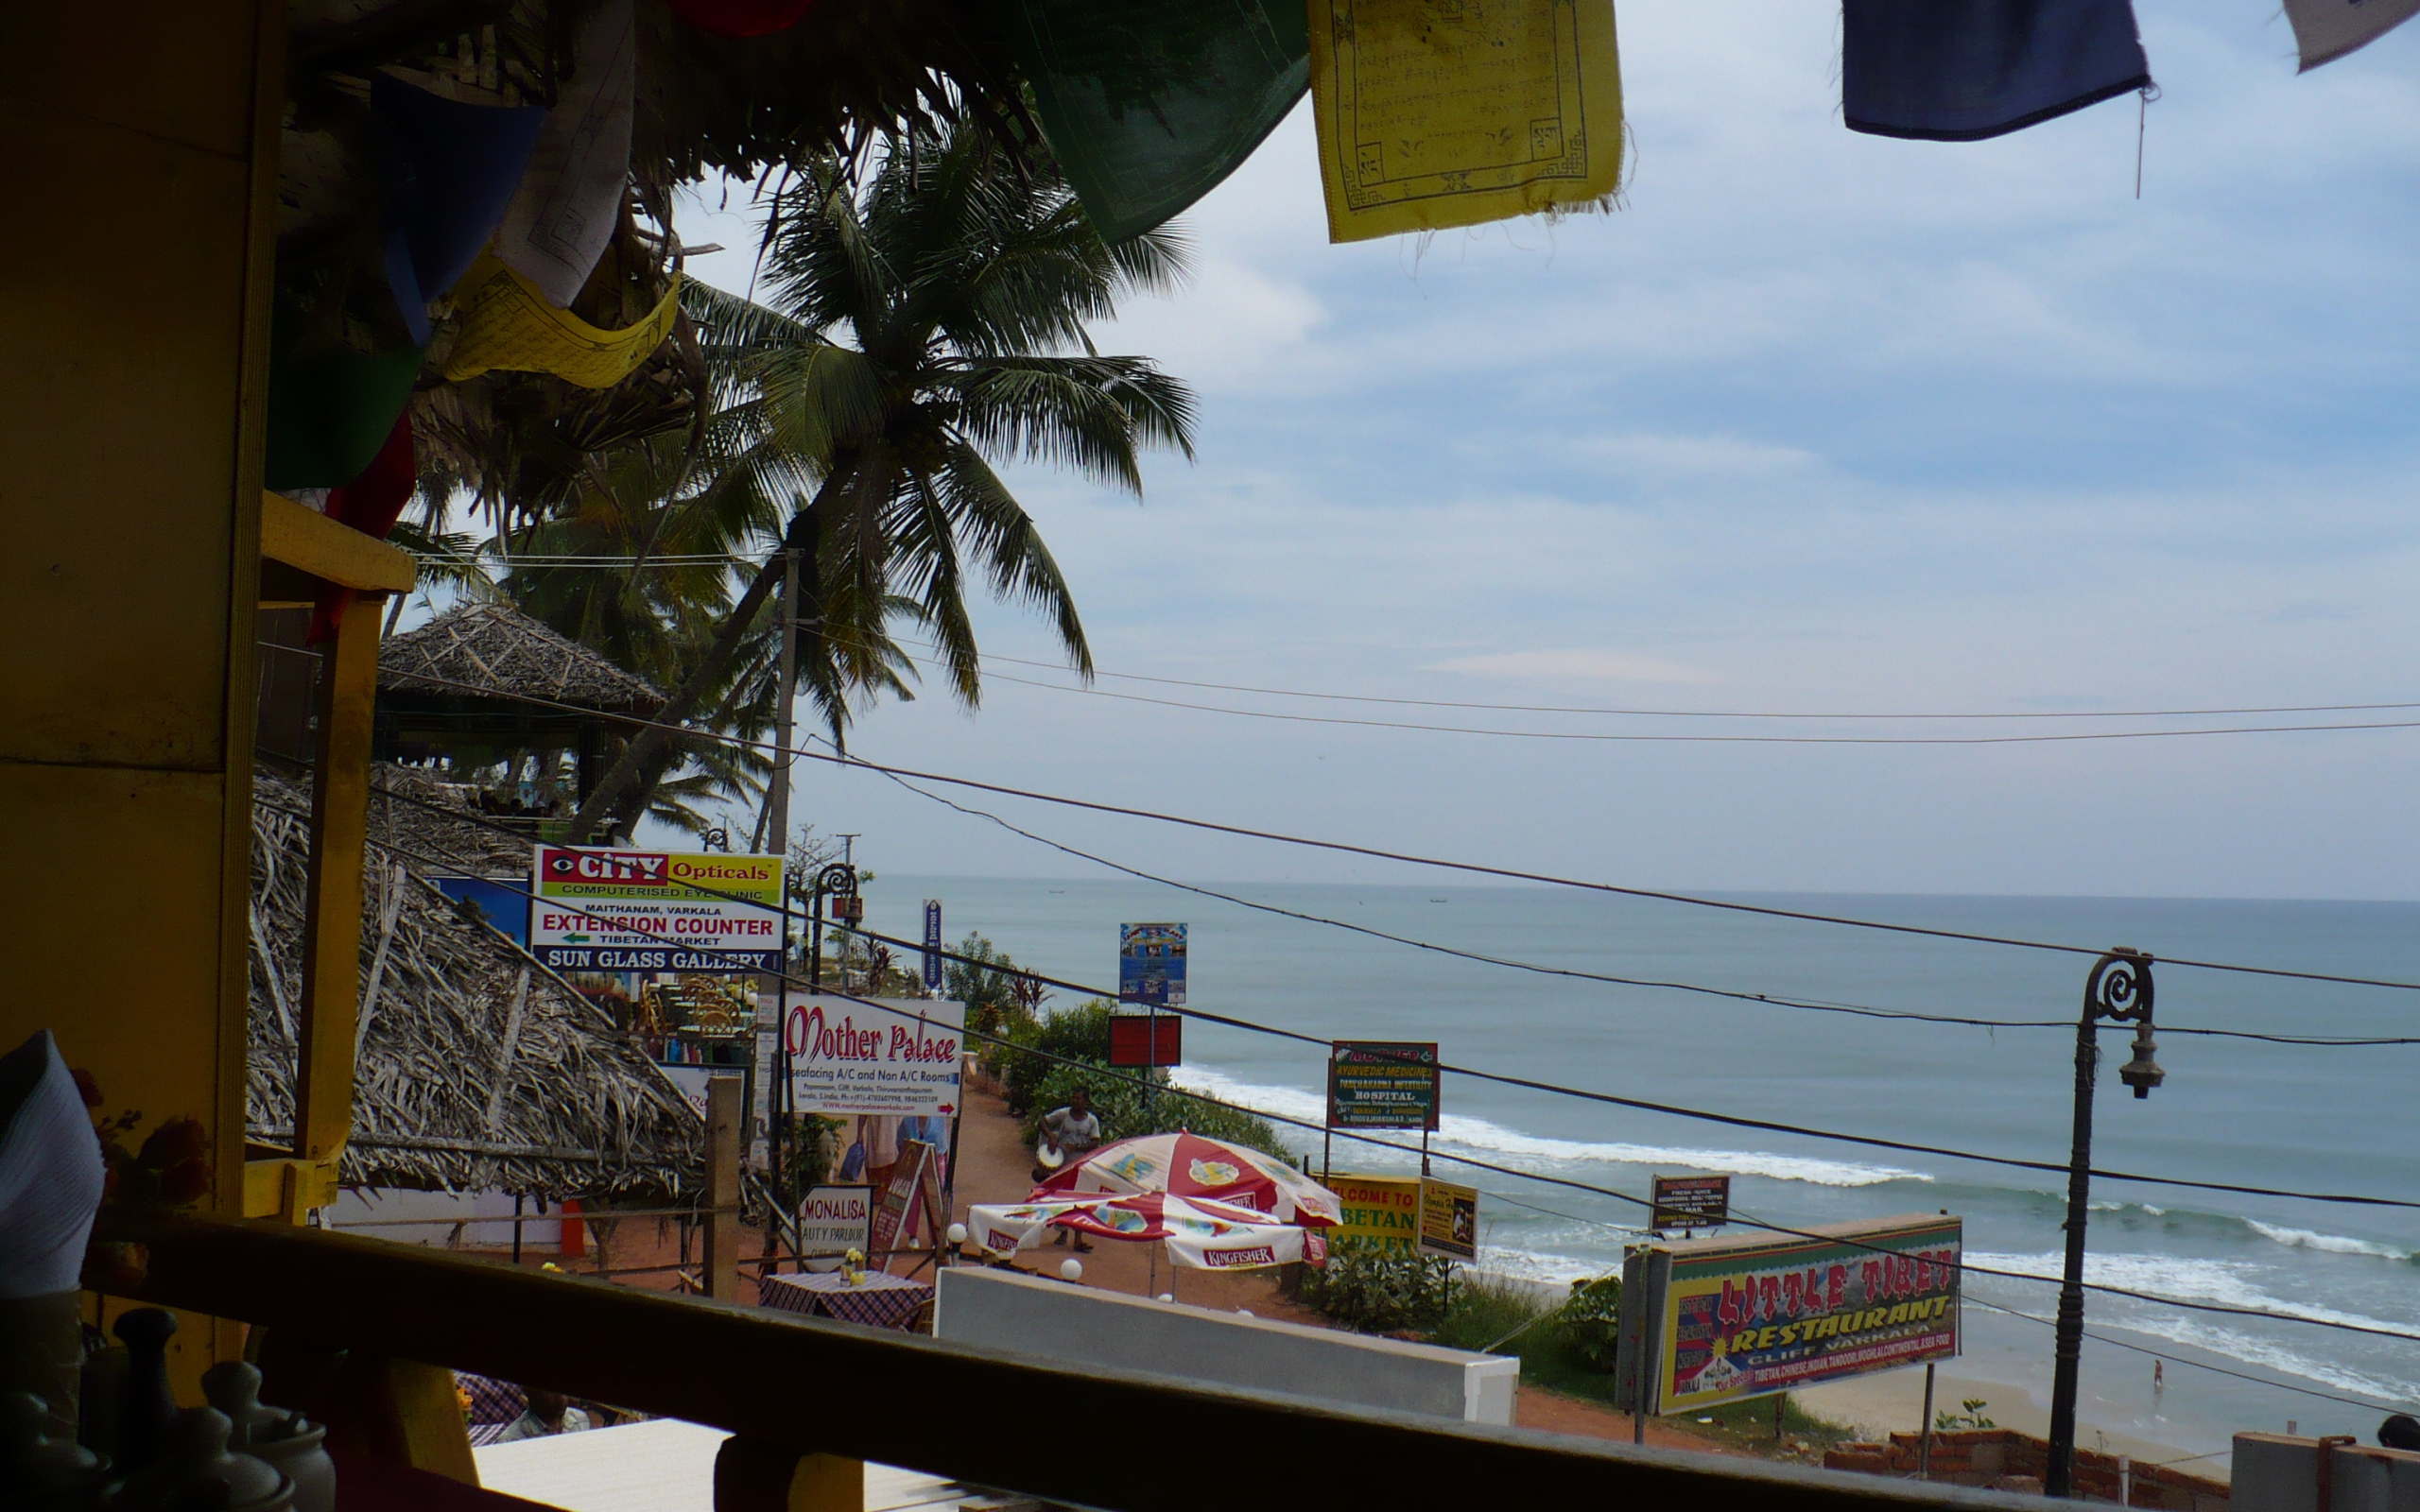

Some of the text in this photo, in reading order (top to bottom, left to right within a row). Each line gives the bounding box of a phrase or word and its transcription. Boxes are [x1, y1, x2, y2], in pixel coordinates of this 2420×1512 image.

[672, 862, 769, 881] Opticals
[562, 885, 680, 897] COMPUTERISED
[718, 890, 763, 901] INIC
[585, 904, 721, 916] MAITHANAM, VARKALA
[543, 914, 773, 936] EXTENSION COUNTER
[599, 936, 660, 944] TIBETAN
[548, 950, 592, 967] SUN
[597, 951, 666, 969] GLASS
[672, 953, 767, 970] GALLERY
[786, 1005, 956, 1063] Mother Palace
[837, 1068, 855, 1079] A/C
[857, 1069, 875, 1080] and
[878, 1070, 897, 1081] Non
[900, 1070, 918, 1082] A/C
[921, 1071, 950, 1082] Rooms
[1337, 1065, 1433, 1077] AYURVEDIC MEDICINES
[1355, 1091, 1415, 1101] HOSPITAL
[804, 1199, 866, 1220] MONALISA
[1394, 1193, 1414, 1208] TO
[1340, 1208, 1416, 1230] BETAN
[791, 1227, 865, 1242] AUTY PARLOUR
[1208, 1247, 1272, 1266] KINGFISHER
[1718, 1249, 1953, 1324] LITTLE TIBET
[1731, 1296, 1950, 1353] RESTAURANT
[1748, 1324, 1930, 1366] CLIFF VARKALA
[1935, 1333, 1950, 1346] FOOD
